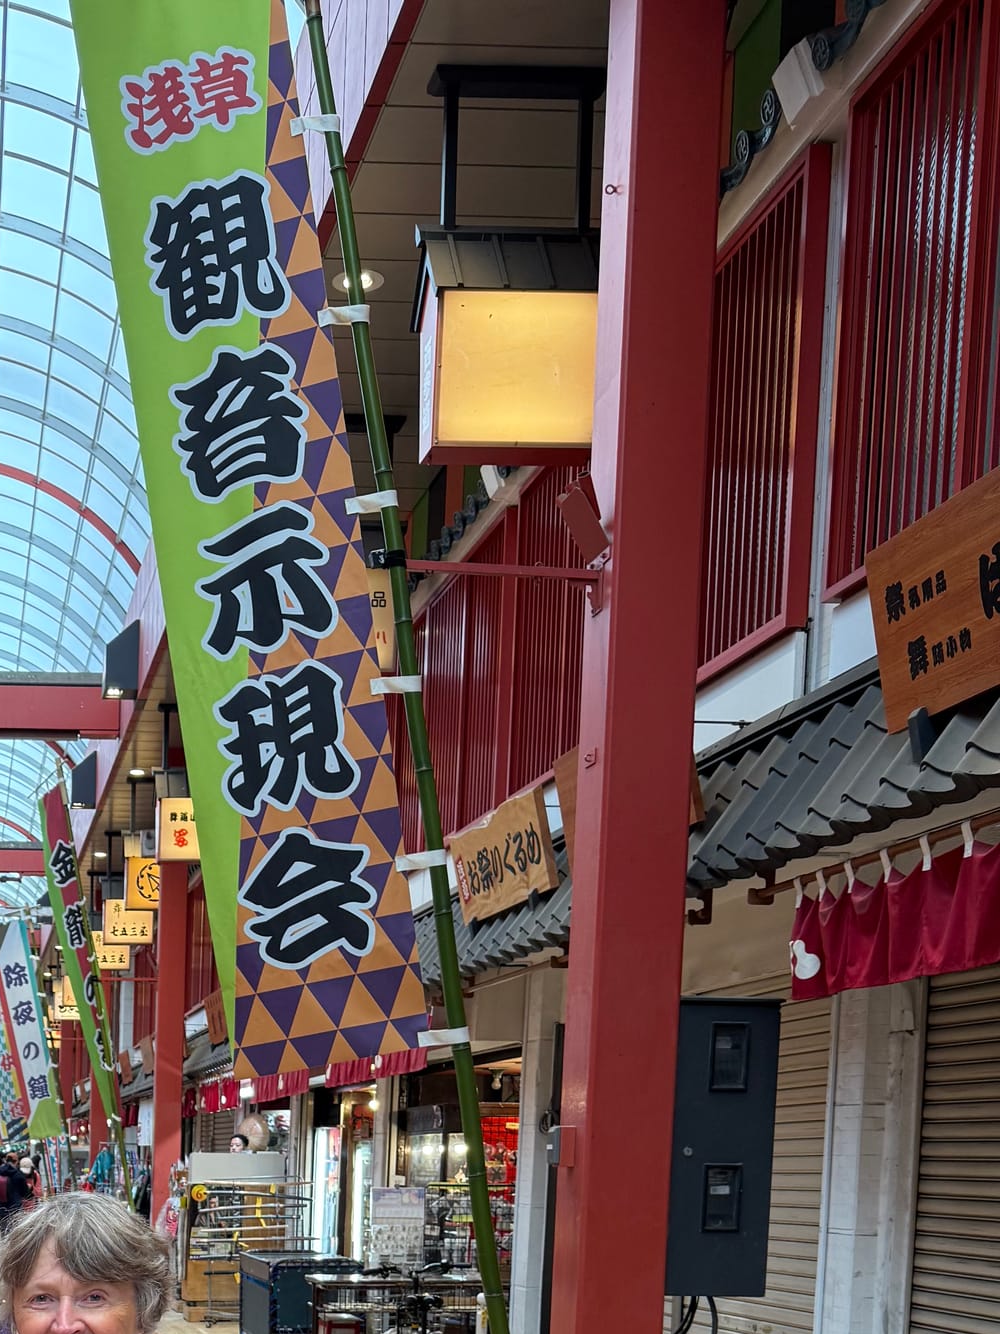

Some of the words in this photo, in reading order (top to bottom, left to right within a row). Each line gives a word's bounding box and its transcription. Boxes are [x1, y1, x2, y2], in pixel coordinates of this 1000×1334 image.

[126, 53, 258, 149] 浅草
[150, 175, 375, 962] 観音示現会
[467, 822, 541, 896] お祭りぐるめ
[3, 961, 50, 1101] 除夜の鐘
